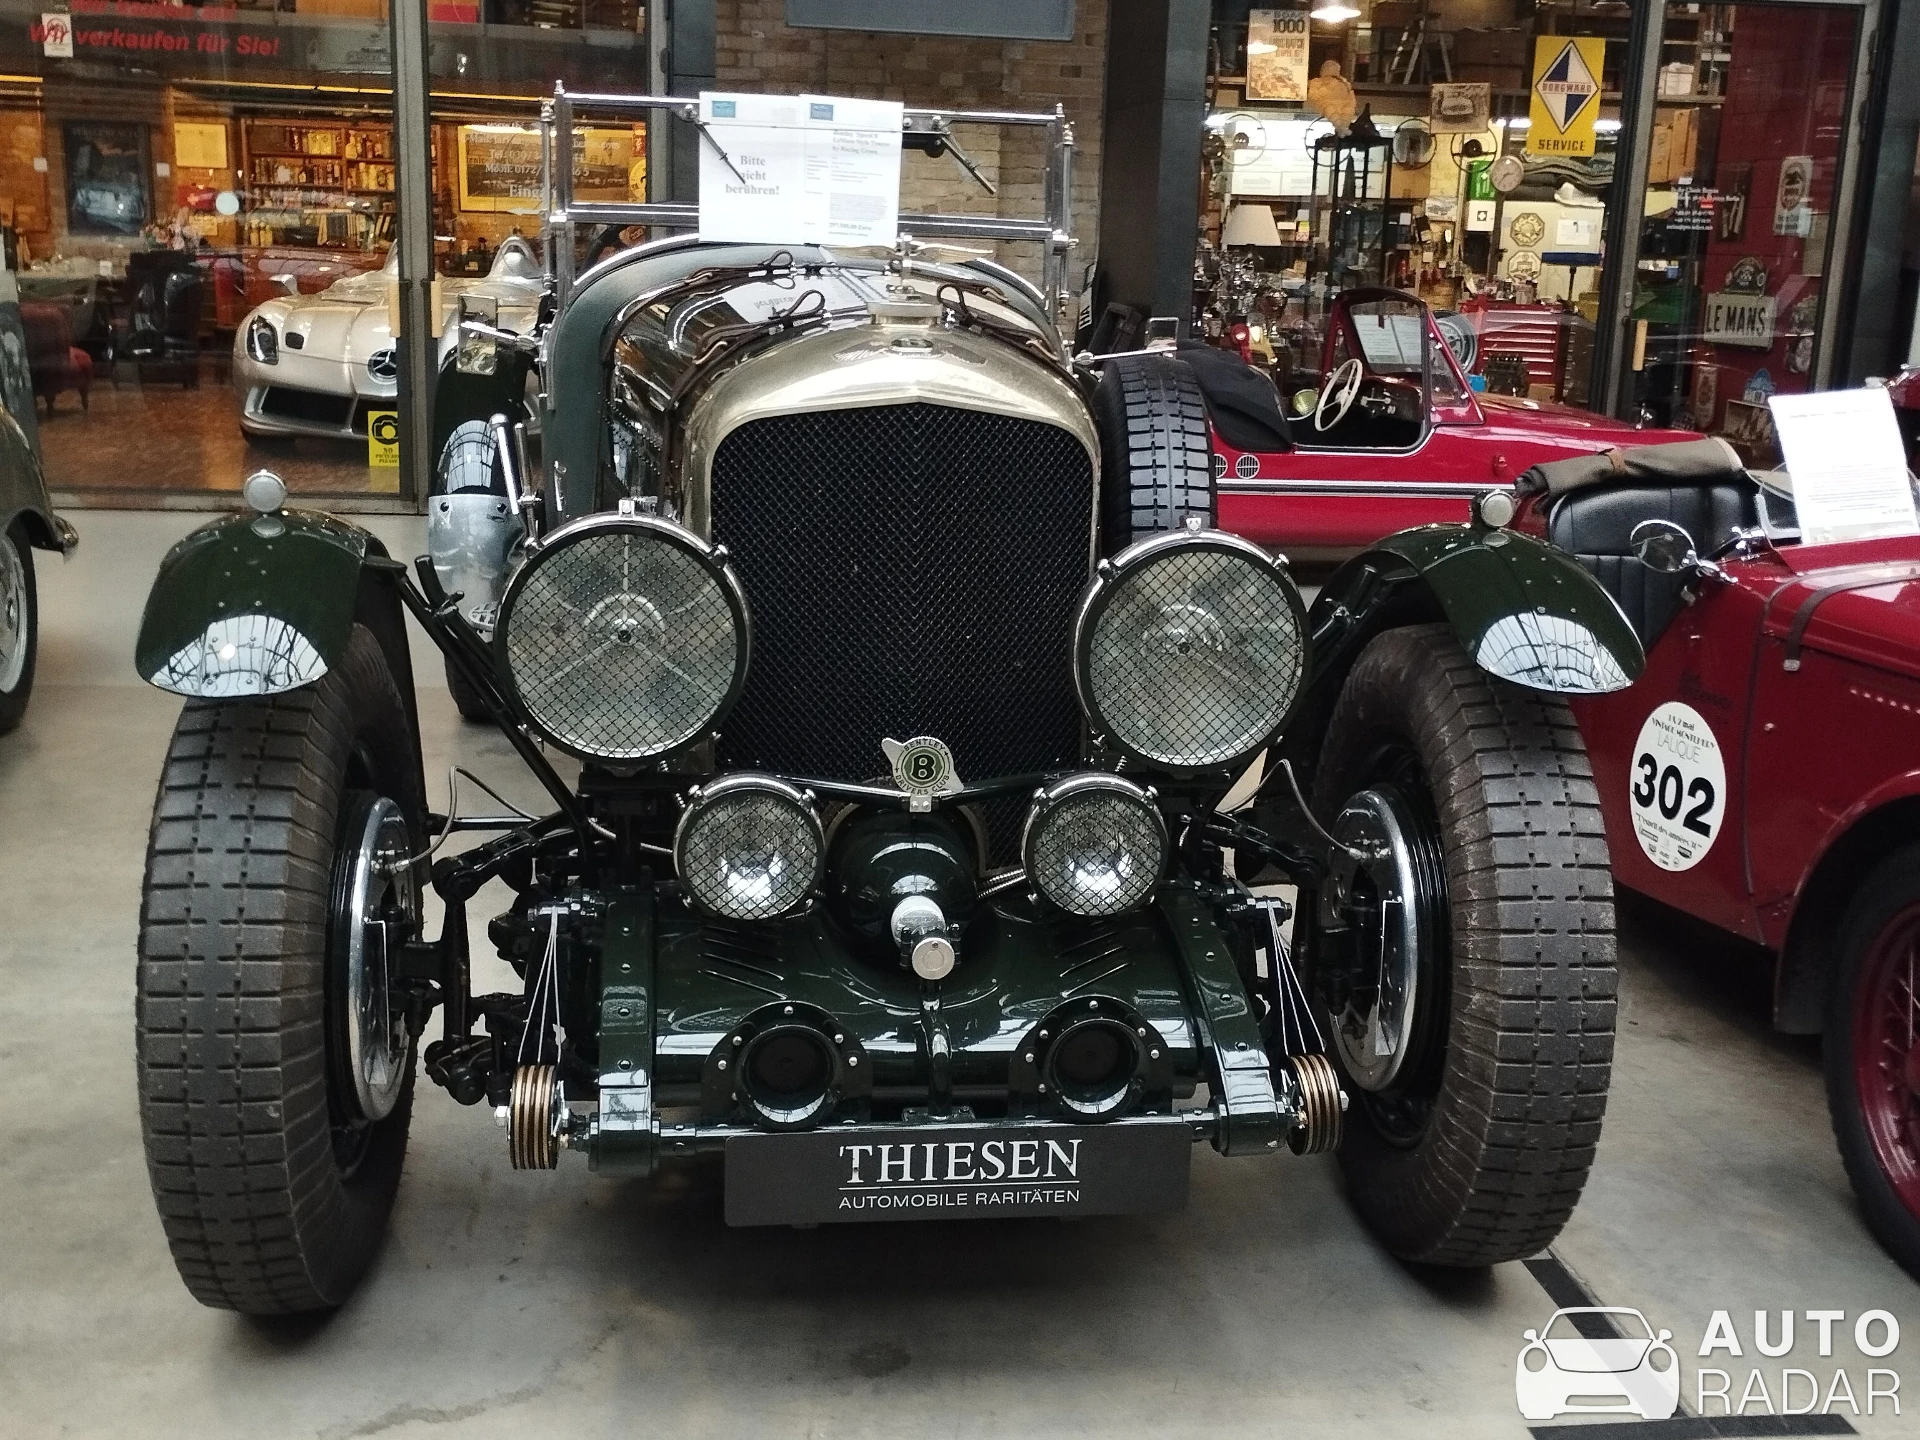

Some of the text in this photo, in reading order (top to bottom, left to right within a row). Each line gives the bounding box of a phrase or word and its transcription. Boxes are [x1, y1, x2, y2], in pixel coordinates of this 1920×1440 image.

[1273, 19, 1305, 33] 1000
[76, 27, 189, 51] verkaufen
[197, 33, 229, 54] für
[236, 35, 280, 56] Sie!
[1538, 139, 1586, 152] SERVICE
[740, 155, 766, 166] Bitte
[725, 184, 780, 196] berühren!
[1706, 304, 1767, 337] LE MANS
[904, 739, 946, 751] BENTLEY
[1657, 730, 1701, 764] LALIQUE
[895, 775, 950, 795] DRIVERS CLUB
[1634, 753, 1715, 839] 302
[839, 1139, 1083, 1184] THIESEN
[839, 1188, 1080, 1209] AUTOMOBILE RARITÄTEN
